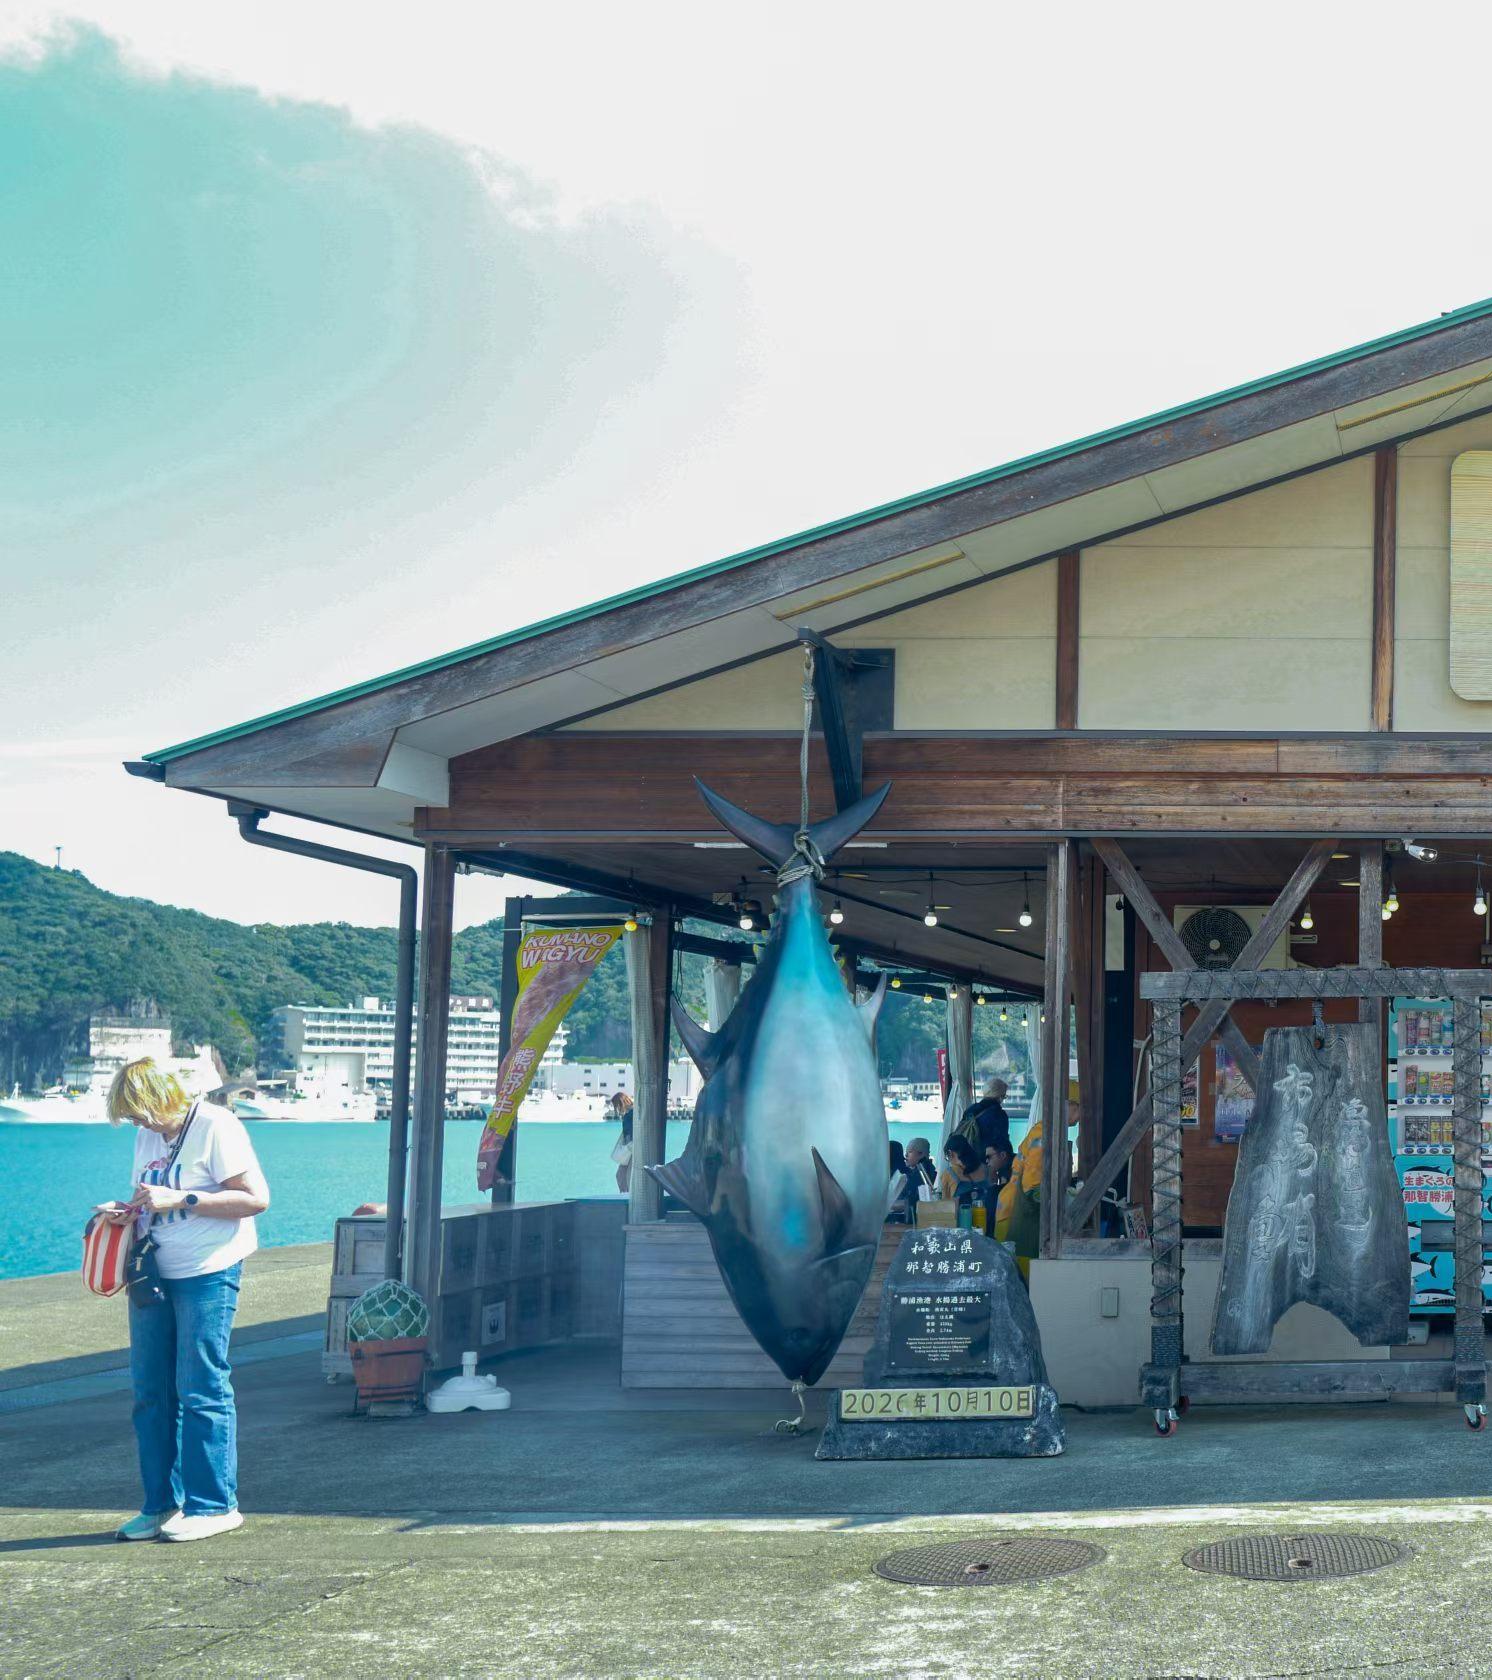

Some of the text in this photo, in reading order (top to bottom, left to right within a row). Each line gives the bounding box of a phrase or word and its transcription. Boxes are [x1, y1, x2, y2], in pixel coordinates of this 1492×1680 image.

[525, 932, 611, 948] KUMANO
[494, 1048, 536, 1119] 熊野牛
[911, 1239, 973, 1254] 和歌山県
[906, 1260, 983, 1275] 那智勝浦町
